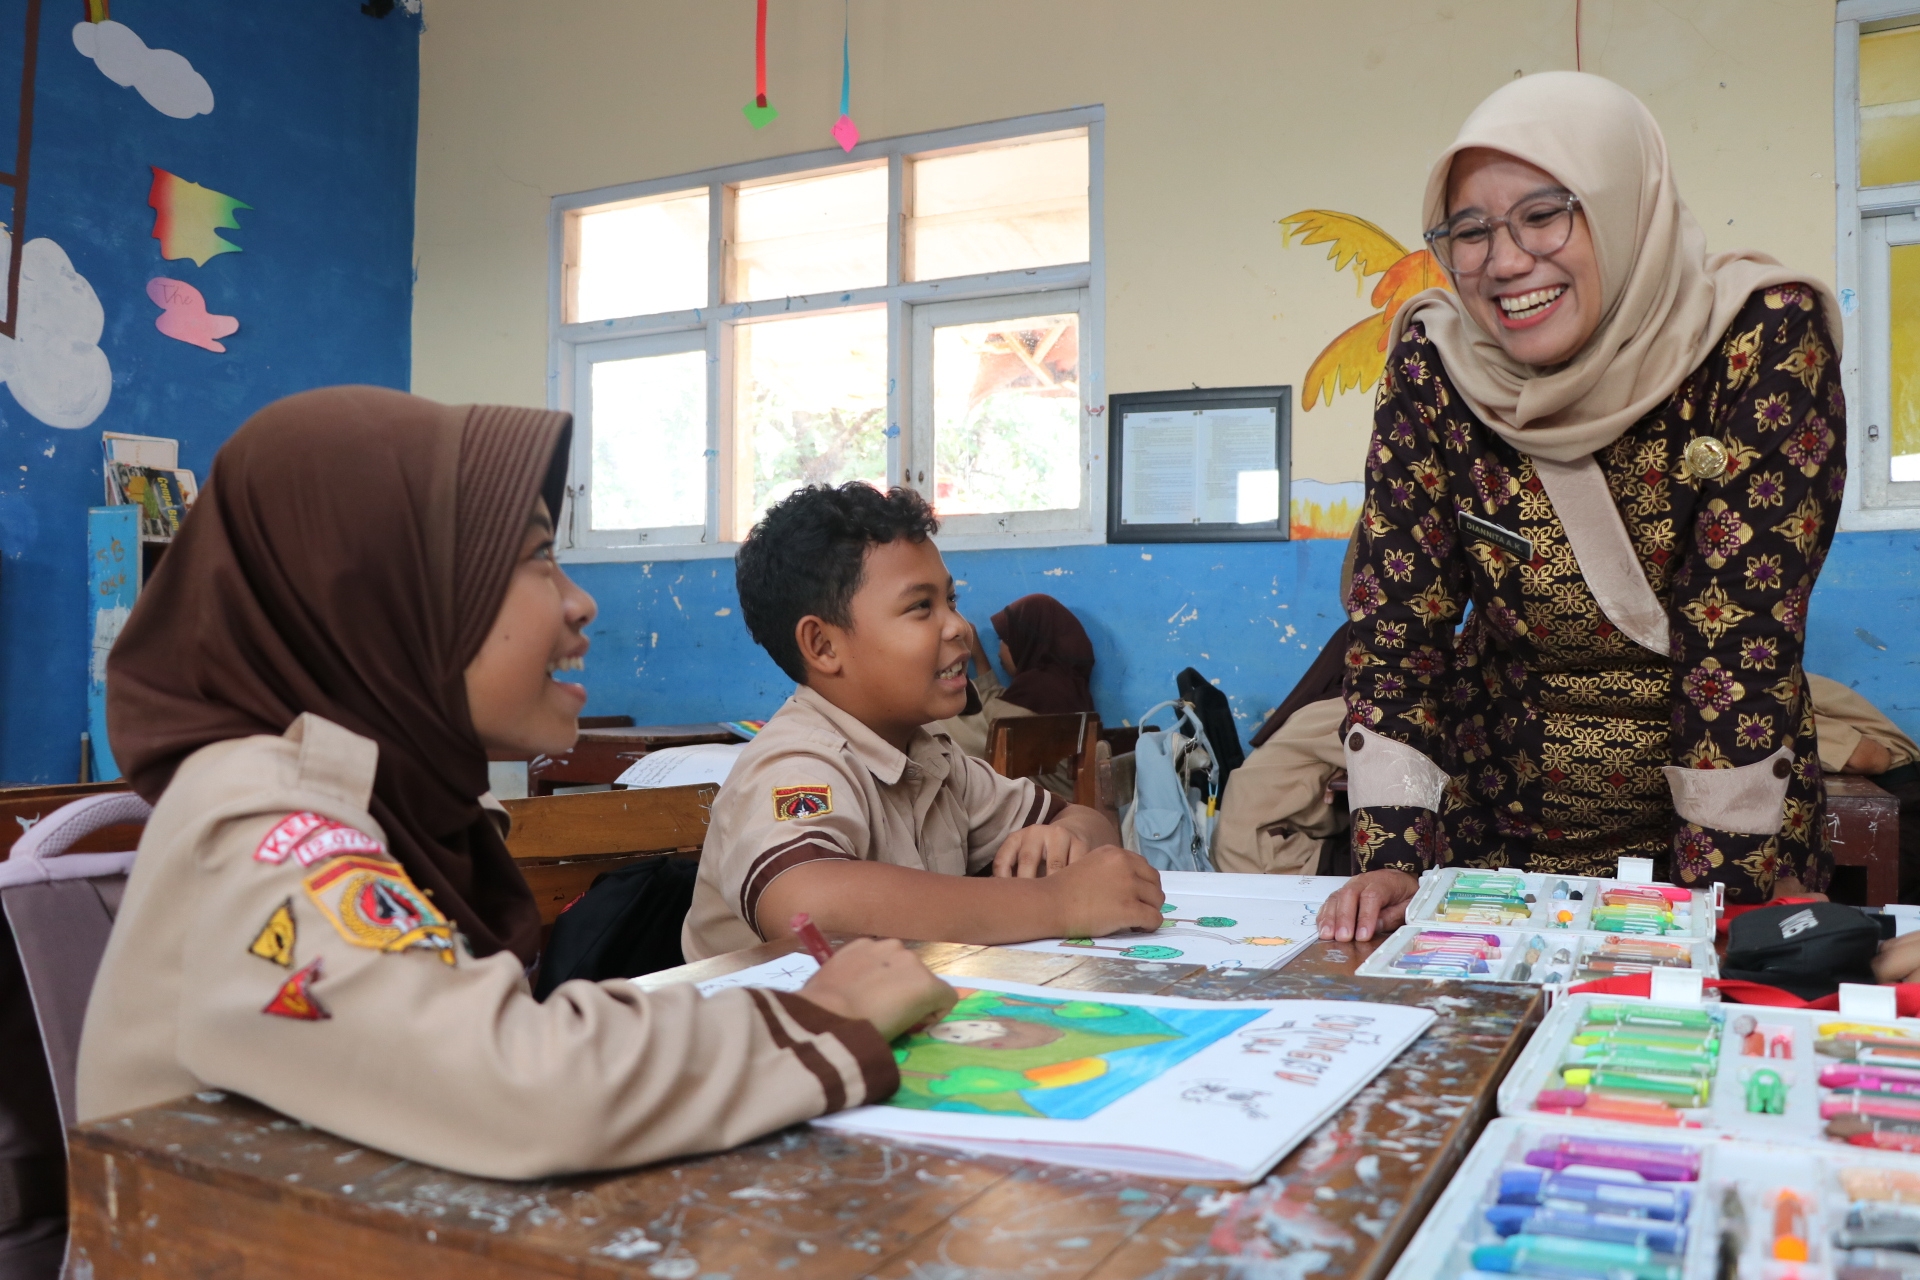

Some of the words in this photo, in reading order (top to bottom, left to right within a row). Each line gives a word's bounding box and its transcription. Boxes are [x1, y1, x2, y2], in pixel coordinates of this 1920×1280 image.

[157, 476, 174, 507] Gempa
[1466, 522, 1504, 544] DIANNITA
[1505, 540, 1523, 552] A.K.
